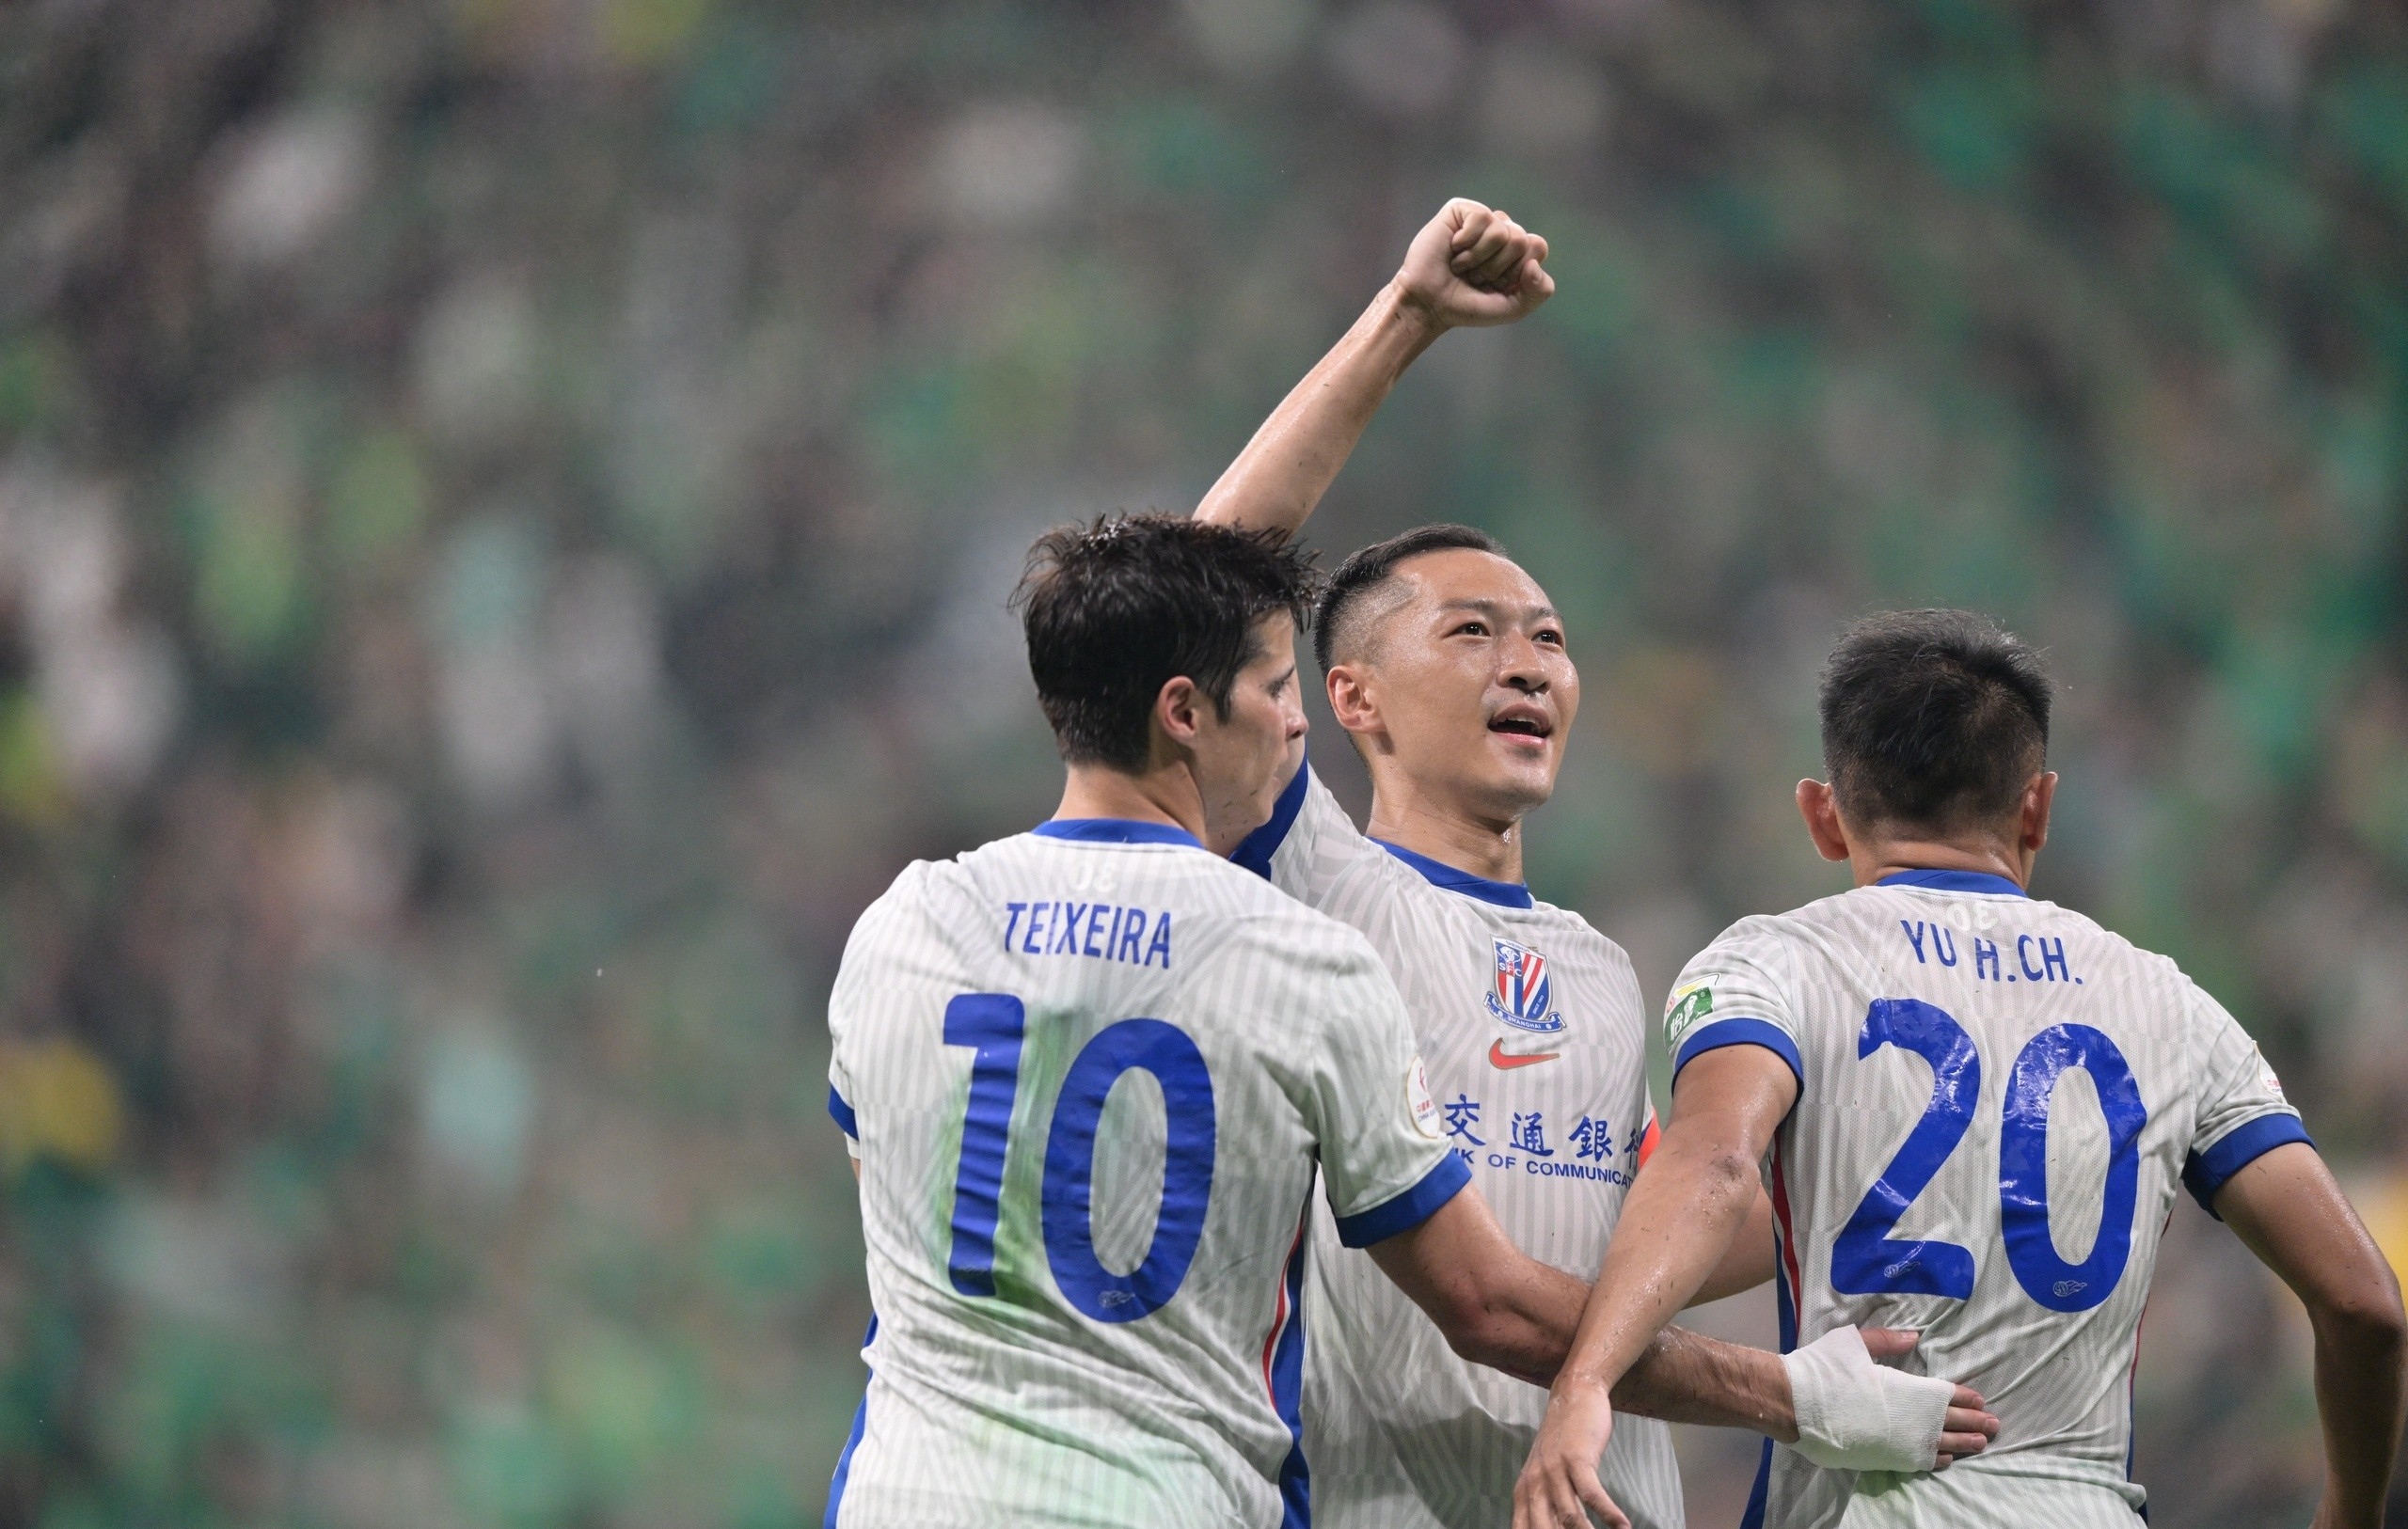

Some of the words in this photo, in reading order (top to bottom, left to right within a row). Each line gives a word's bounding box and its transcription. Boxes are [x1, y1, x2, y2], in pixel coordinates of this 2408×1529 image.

[1005, 902, 1171, 969] TEIXEIRA
[1900, 920, 1957, 967] YU
[1974, 934, 2083, 985] H.CH.
[1498, 962, 1522, 977] SFC
[1507, 1016, 1542, 1030] SHANGHAI
[943, 993, 1216, 1323] 10
[1487, 1154, 1516, 1170] OF
[1830, 998, 2147, 1313] 20
